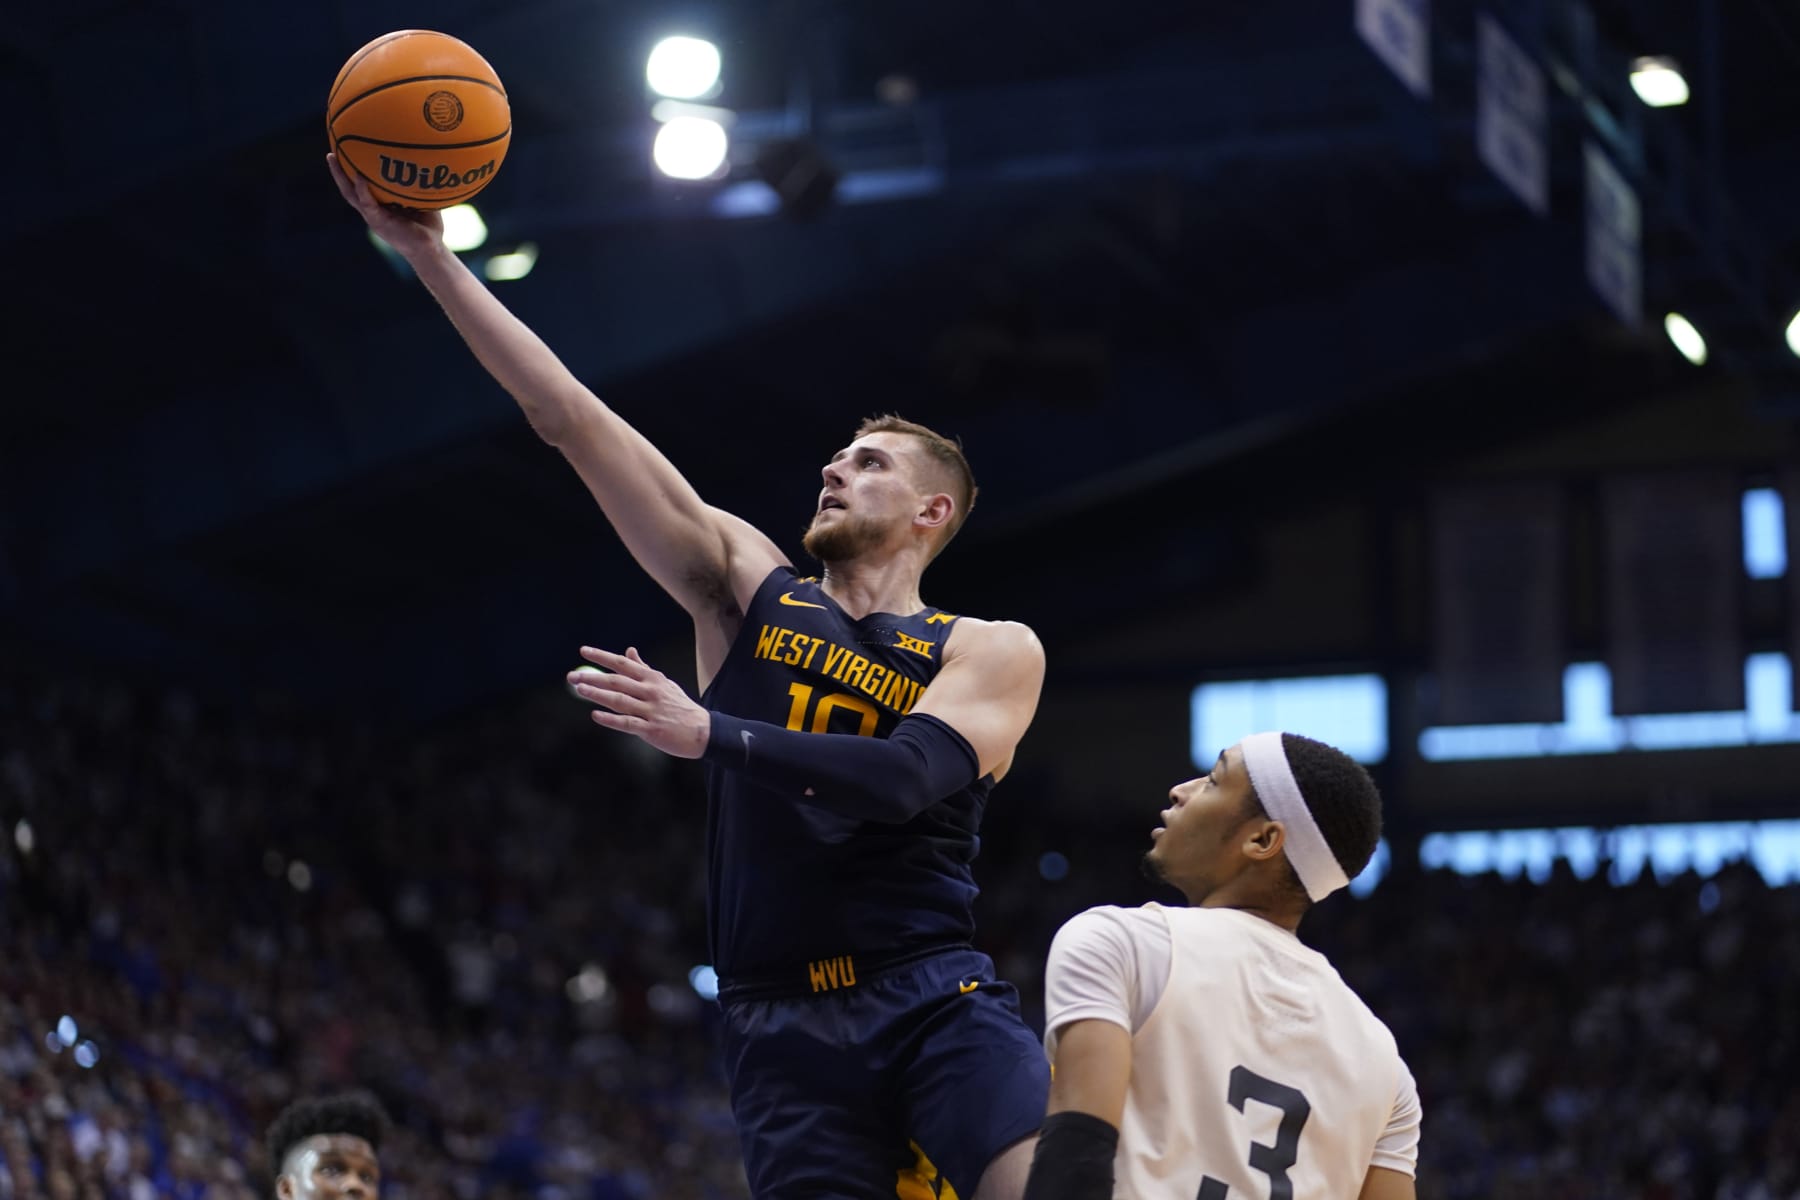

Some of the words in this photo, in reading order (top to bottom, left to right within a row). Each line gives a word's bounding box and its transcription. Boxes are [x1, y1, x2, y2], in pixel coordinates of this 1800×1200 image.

[380, 155, 495, 188] Wilson
[755, 625, 825, 669] WEST
[809, 956, 856, 992] WVU
[1196, 1064, 1311, 1200] 3
